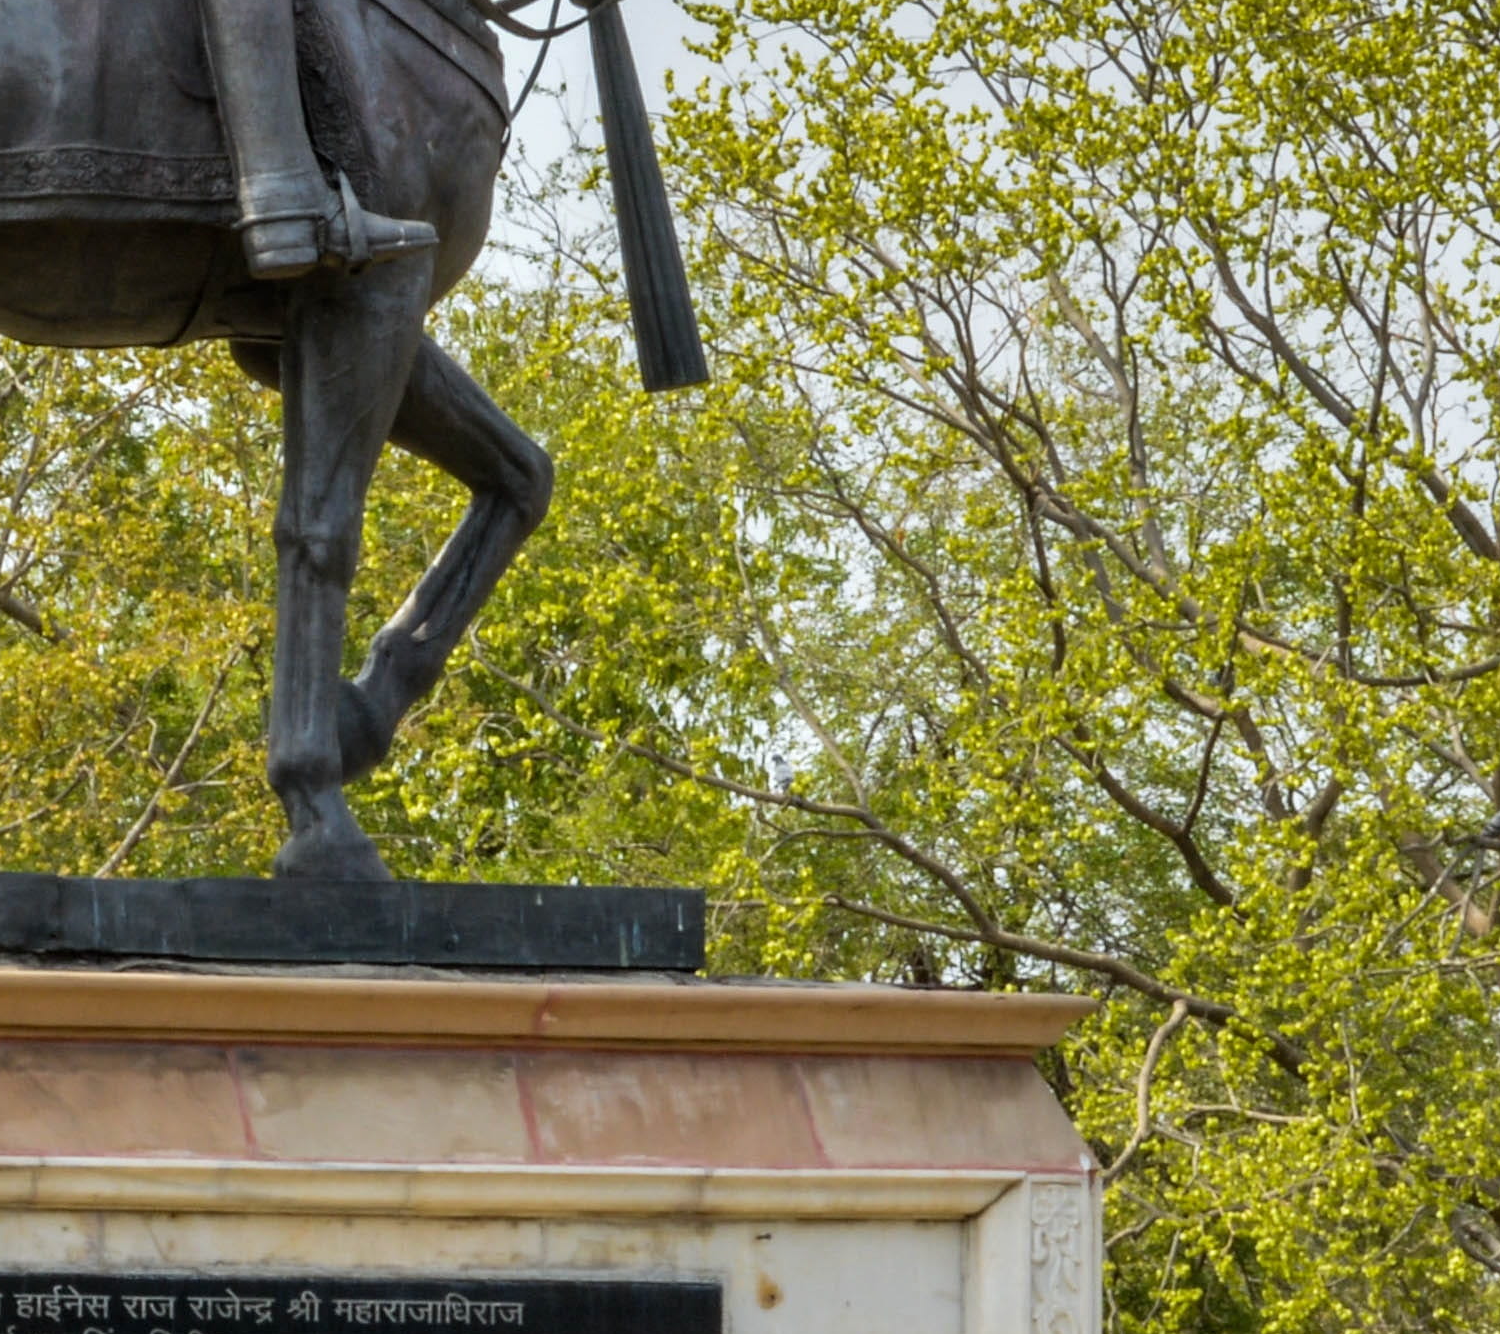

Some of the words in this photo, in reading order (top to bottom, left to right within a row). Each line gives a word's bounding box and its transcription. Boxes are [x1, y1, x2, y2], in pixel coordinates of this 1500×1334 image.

[13, 1286, 110, 1322] हाईनेस
[121, 1295, 175, 1319] राज
[187, 1289, 275, 1324] राजेन्द्र
[286, 1291, 322, 1322] श्री
[333, 1294, 524, 1326] महाराजाधिराज
